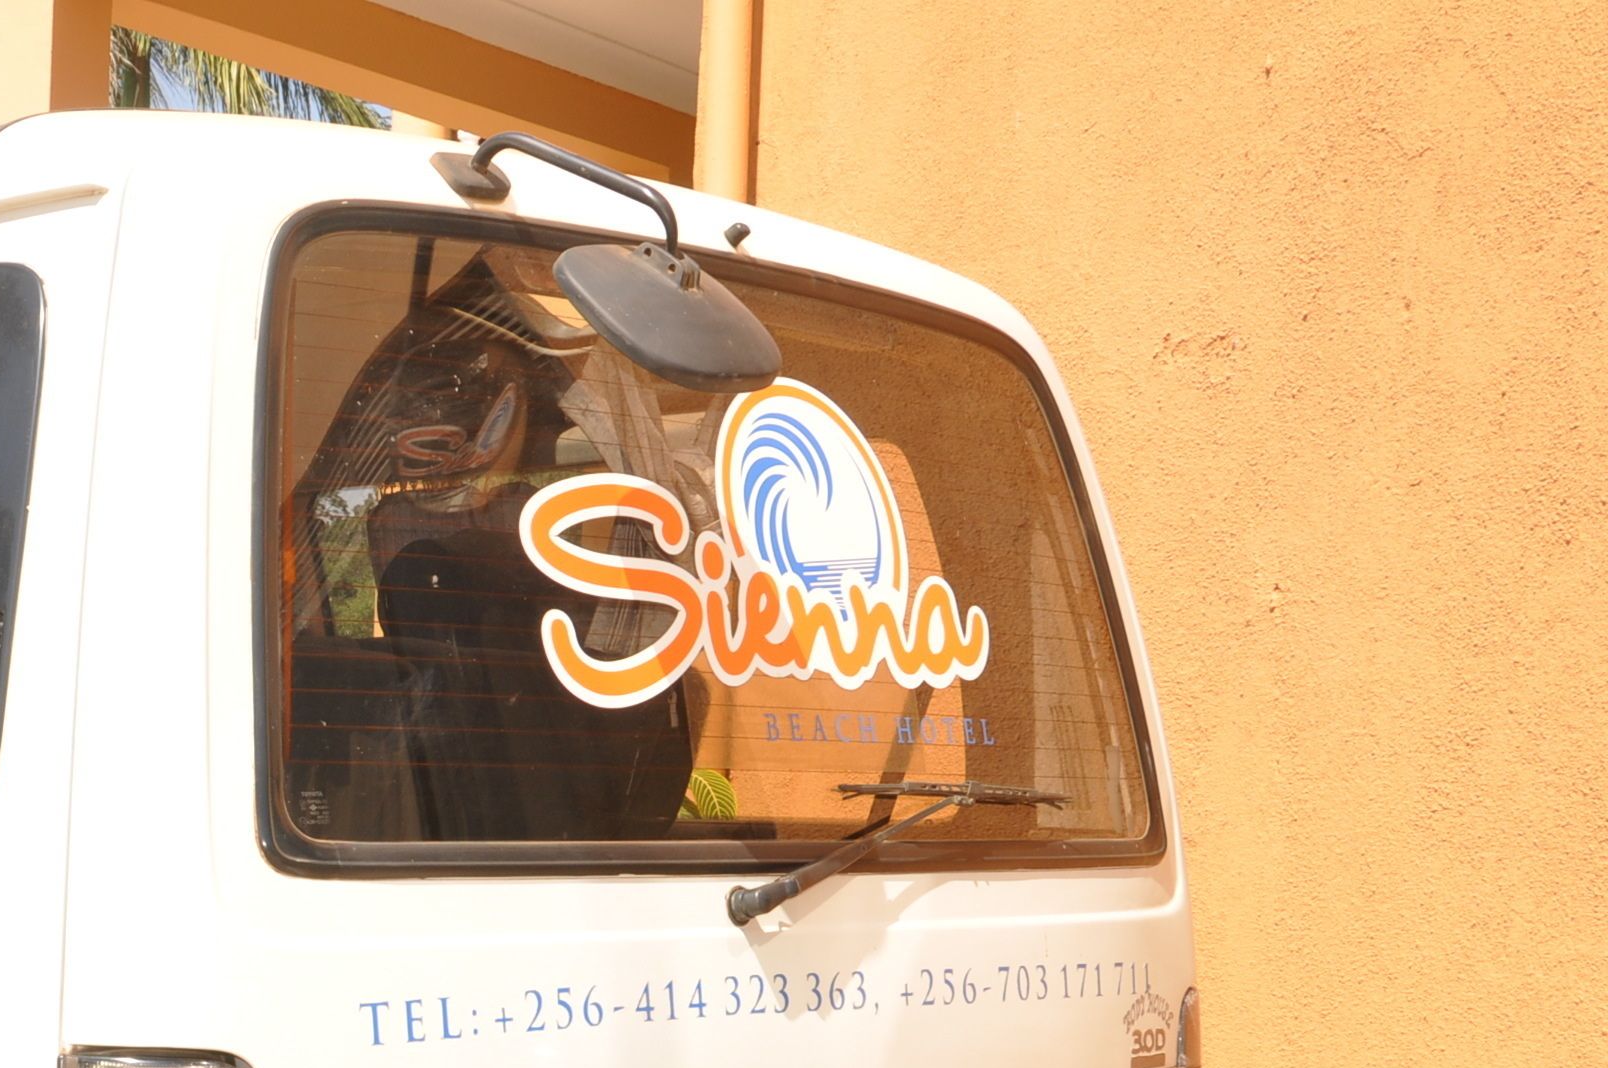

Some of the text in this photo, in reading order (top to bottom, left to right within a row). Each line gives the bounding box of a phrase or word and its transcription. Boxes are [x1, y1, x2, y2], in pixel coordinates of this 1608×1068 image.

[519, 473, 990, 709] Sienna
[763, 712, 997, 746] BEACH HOTEL
